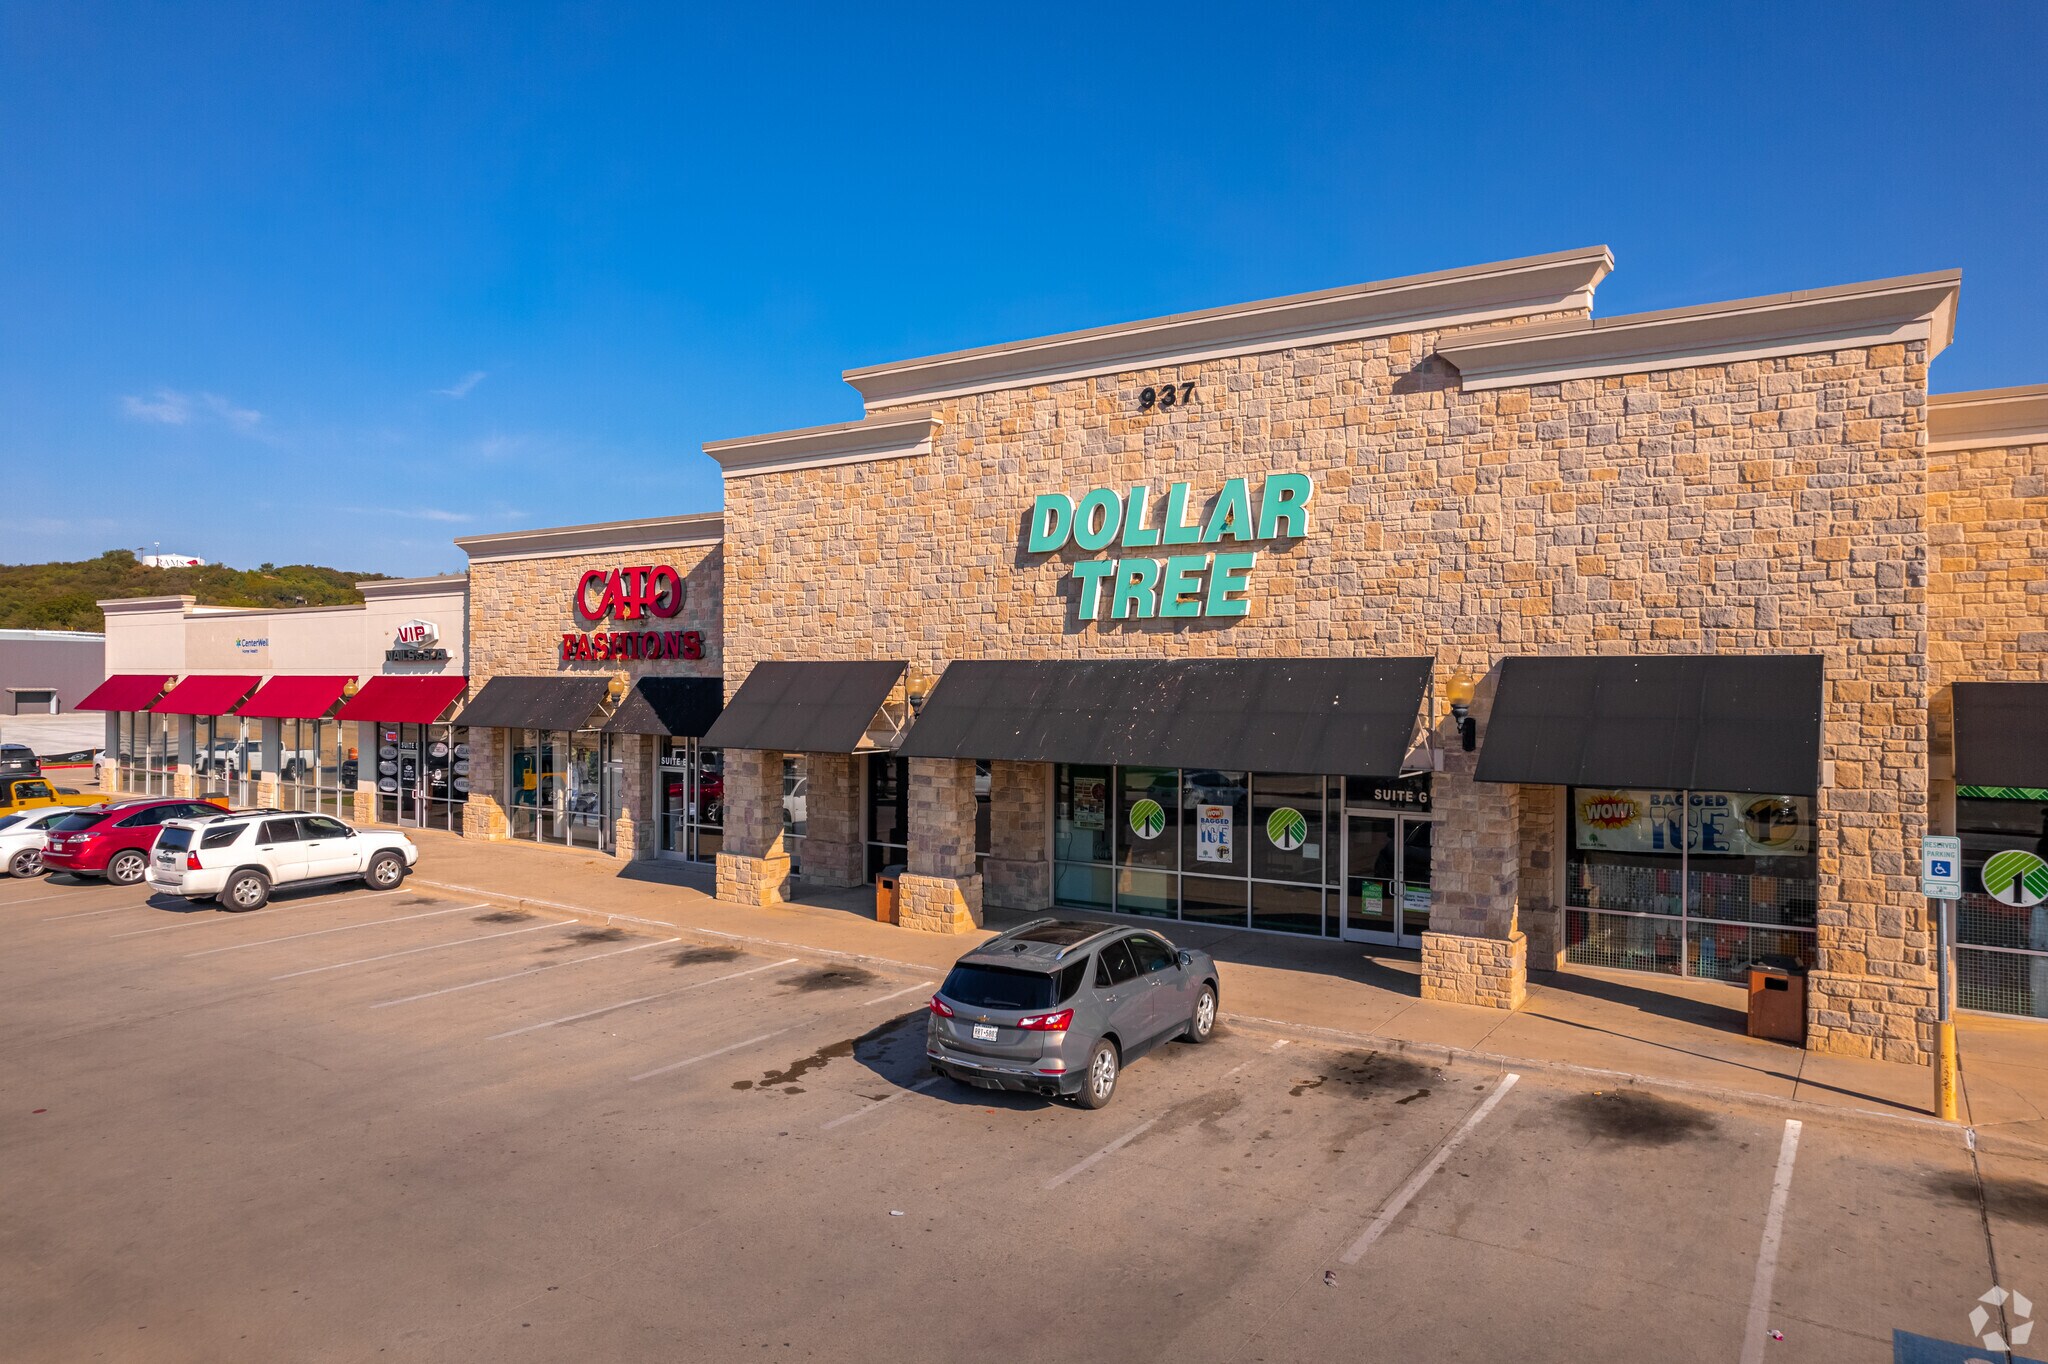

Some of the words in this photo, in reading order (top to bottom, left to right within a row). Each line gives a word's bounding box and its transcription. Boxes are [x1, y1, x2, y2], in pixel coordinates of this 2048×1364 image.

[1138, 382, 1196, 409] 937
[1028, 473, 1314, 553] DOLLAR
[156, 558, 185, 567] RAMS
[577, 565, 684, 621] CATO
[1072, 552, 1257, 620] TREE
[397, 625, 425, 643] VIP
[562, 631, 702, 661] FASHIONS
[661, 756, 681, 766] SUITE
[1374, 788, 1414, 802] SUITE
[1418, 791, 1428, 804] G
[1649, 794, 1729, 807] BAGGED
[1584, 801, 1636, 821] WOW!
[1200, 817, 1230, 825] BAGGED
[1649, 806, 1731, 852] ICE
[1200, 823, 1231, 845] ICE
[1924, 841, 1957, 850] RESERVED
[1926, 850, 1956, 859] PARKING
